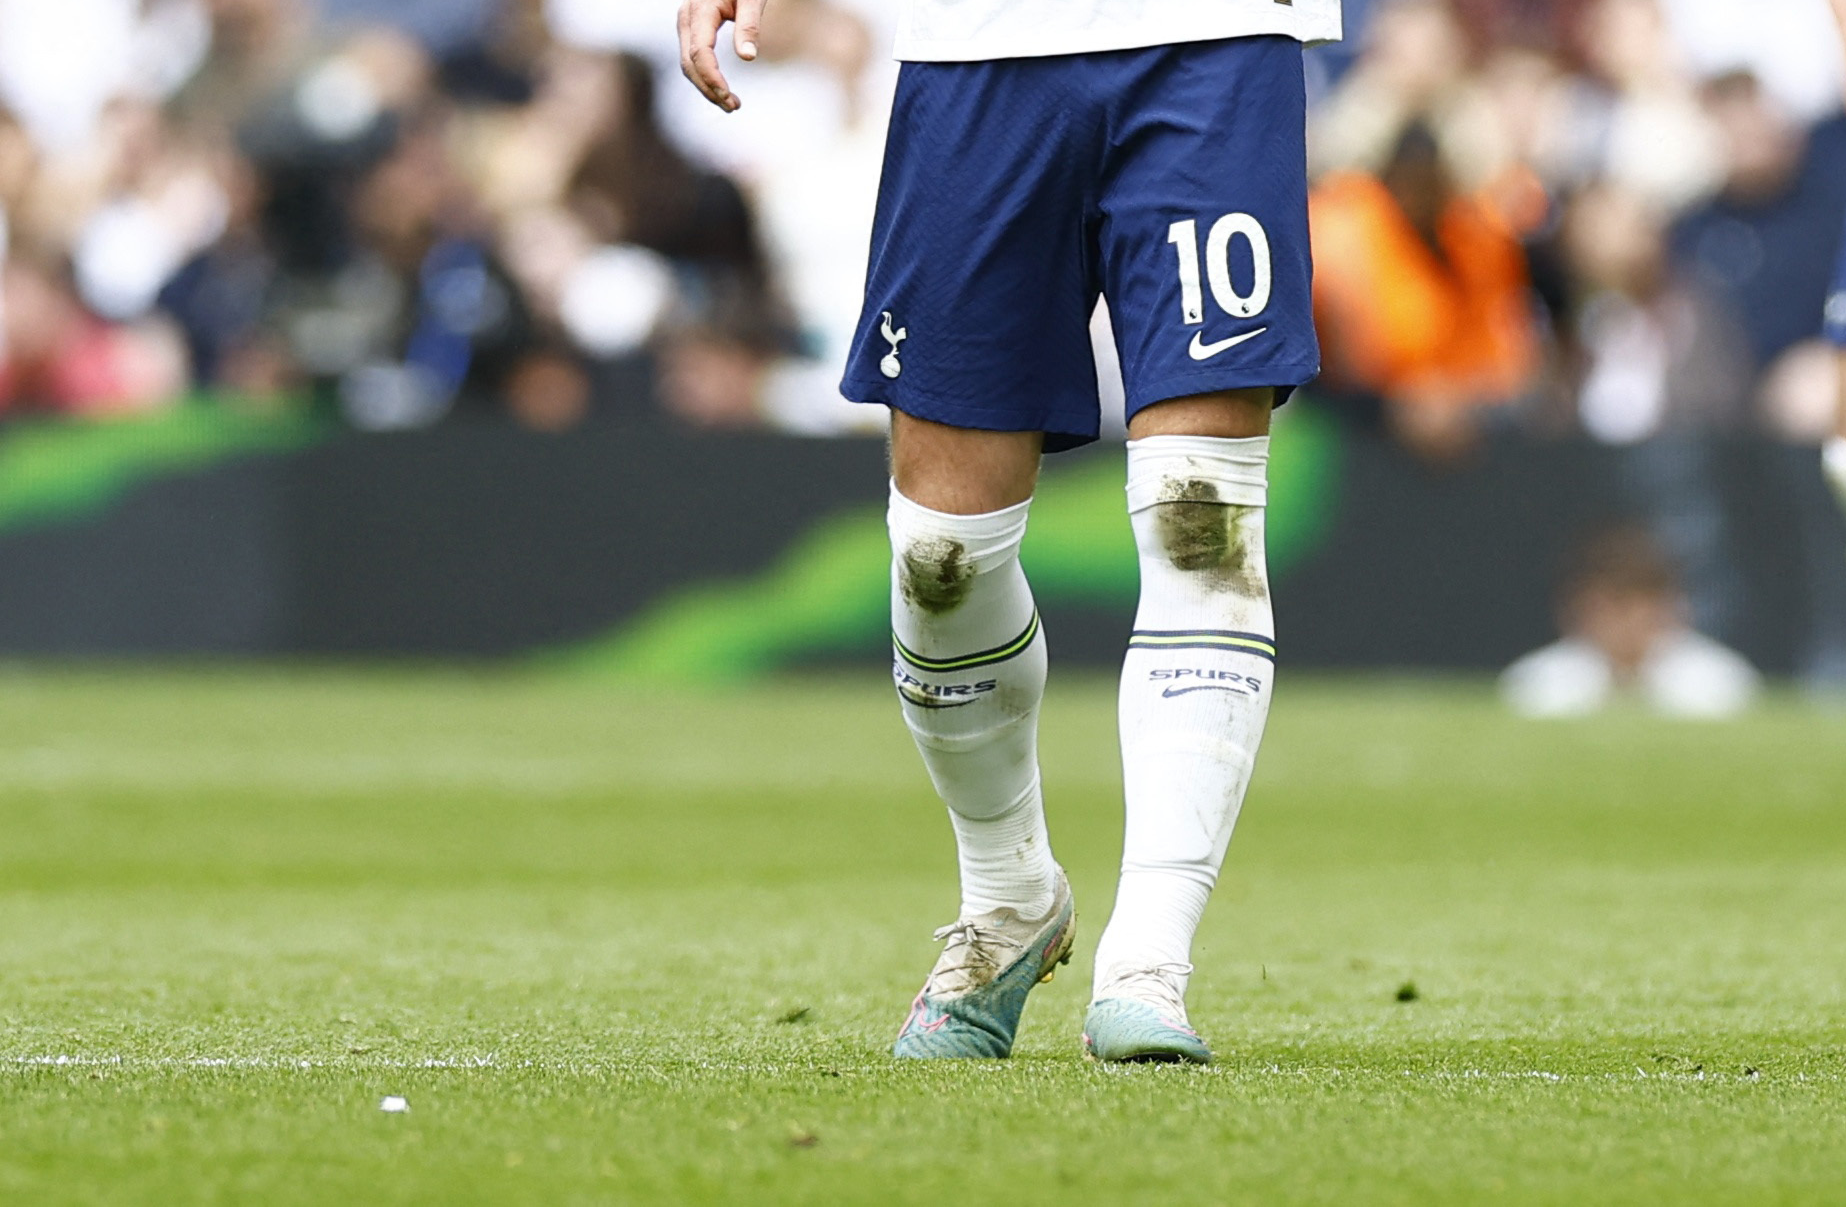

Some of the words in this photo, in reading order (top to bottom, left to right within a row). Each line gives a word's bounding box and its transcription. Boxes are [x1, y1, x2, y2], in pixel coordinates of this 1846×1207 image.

[1166, 212, 1272, 325] 10
[893, 659, 997, 697] SPURS
[1149, 668, 1262, 693] SPURS
